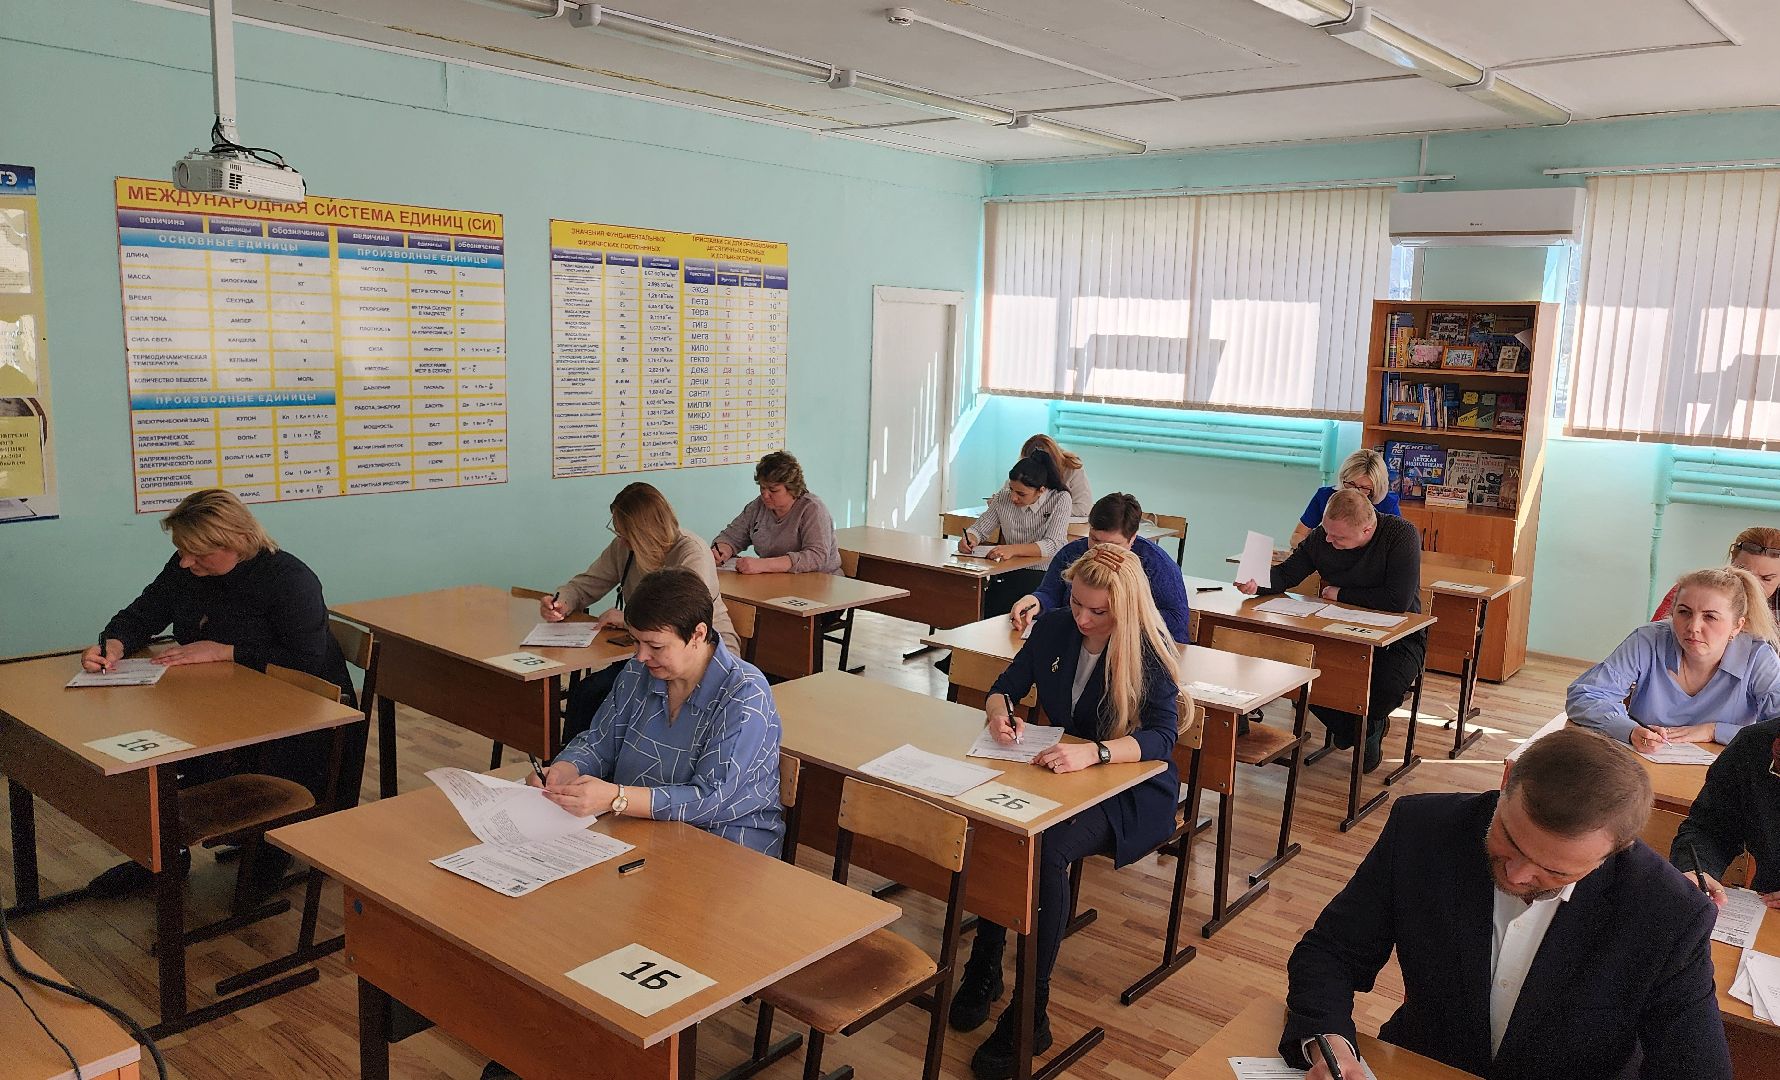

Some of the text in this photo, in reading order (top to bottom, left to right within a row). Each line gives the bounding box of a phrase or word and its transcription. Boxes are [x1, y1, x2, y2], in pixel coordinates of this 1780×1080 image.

[128, 185, 496, 234] МЕЖДУНАРОДНАЯ СИСТЕМА ЕДИНИЦ (СИ)
[140, 216, 185, 226] величина
[272, 227, 325, 237] обозначение
[353, 233, 390, 242] величина
[158, 234, 298, 252] ОСНОВНЫЕ ЕДИНИЦЫ
[358, 248, 488, 264] ПРОИЗВОДНЫЕ ЕДИНИЦЫ
[691, 309, 709, 317] тера
[156, 392, 317, 405] ПРОИЗВОДНЫЕ ЕДИНИЦЫ
[687, 412, 711, 420] микро
[117, 738, 160, 752] 1В
[984, 793, 1031, 811] 2Б
[618, 961, 683, 990] 1Б
